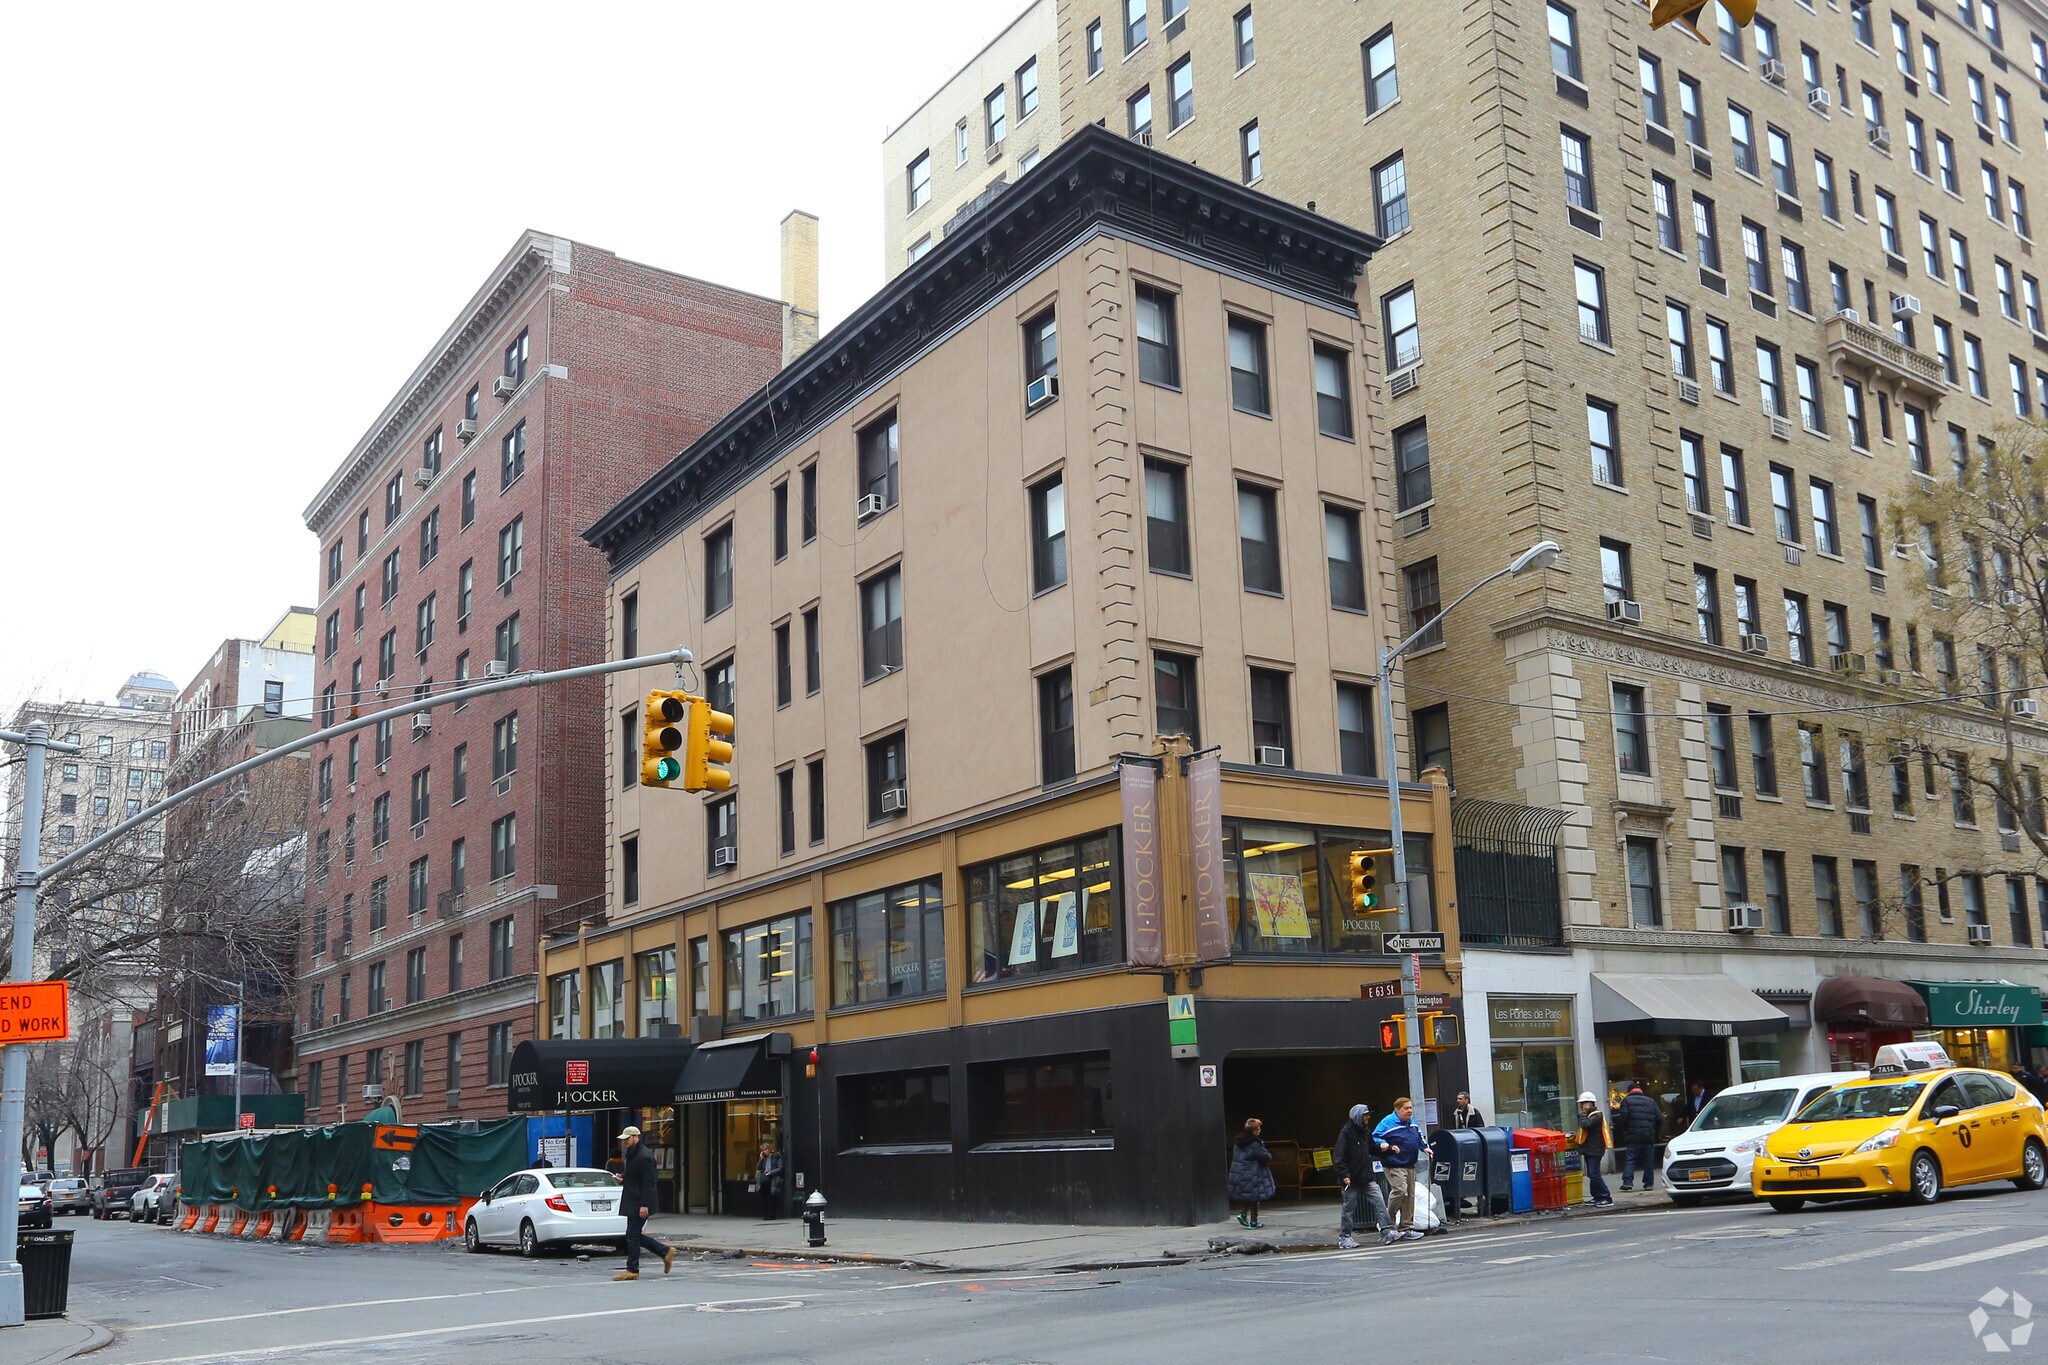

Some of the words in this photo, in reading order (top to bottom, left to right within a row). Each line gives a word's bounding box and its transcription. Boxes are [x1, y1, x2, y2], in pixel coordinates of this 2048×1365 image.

[1392, 939, 1410, 948] ONE
[1418, 939, 1437, 947] WAY
[1368, 987, 1373, 998] E
[1375, 985, 1384, 997] 63
[1386, 984, 1395, 996] St
[0, 996, 32, 1010] END
[1416, 995, 1443, 1007] Lexington
[1955, 988, 2020, 1023] Shirley
[1494, 1008, 1508, 1020] Les
[1509, 1008, 1533, 1020] Portes
[1533, 1008, 1544, 1020] de
[1545, 1008, 1562, 1020] Paris
[19, 1017, 60, 1032] WORK
[1500, 1062, 1513, 1071] 826
[1877, 1065, 1895, 1073] 7A14
[674, 1093, 694, 1102] BESPOKE
[694, 1092, 712, 1100] FRAMES
[717, 1090, 735, 1099] PRINTS
